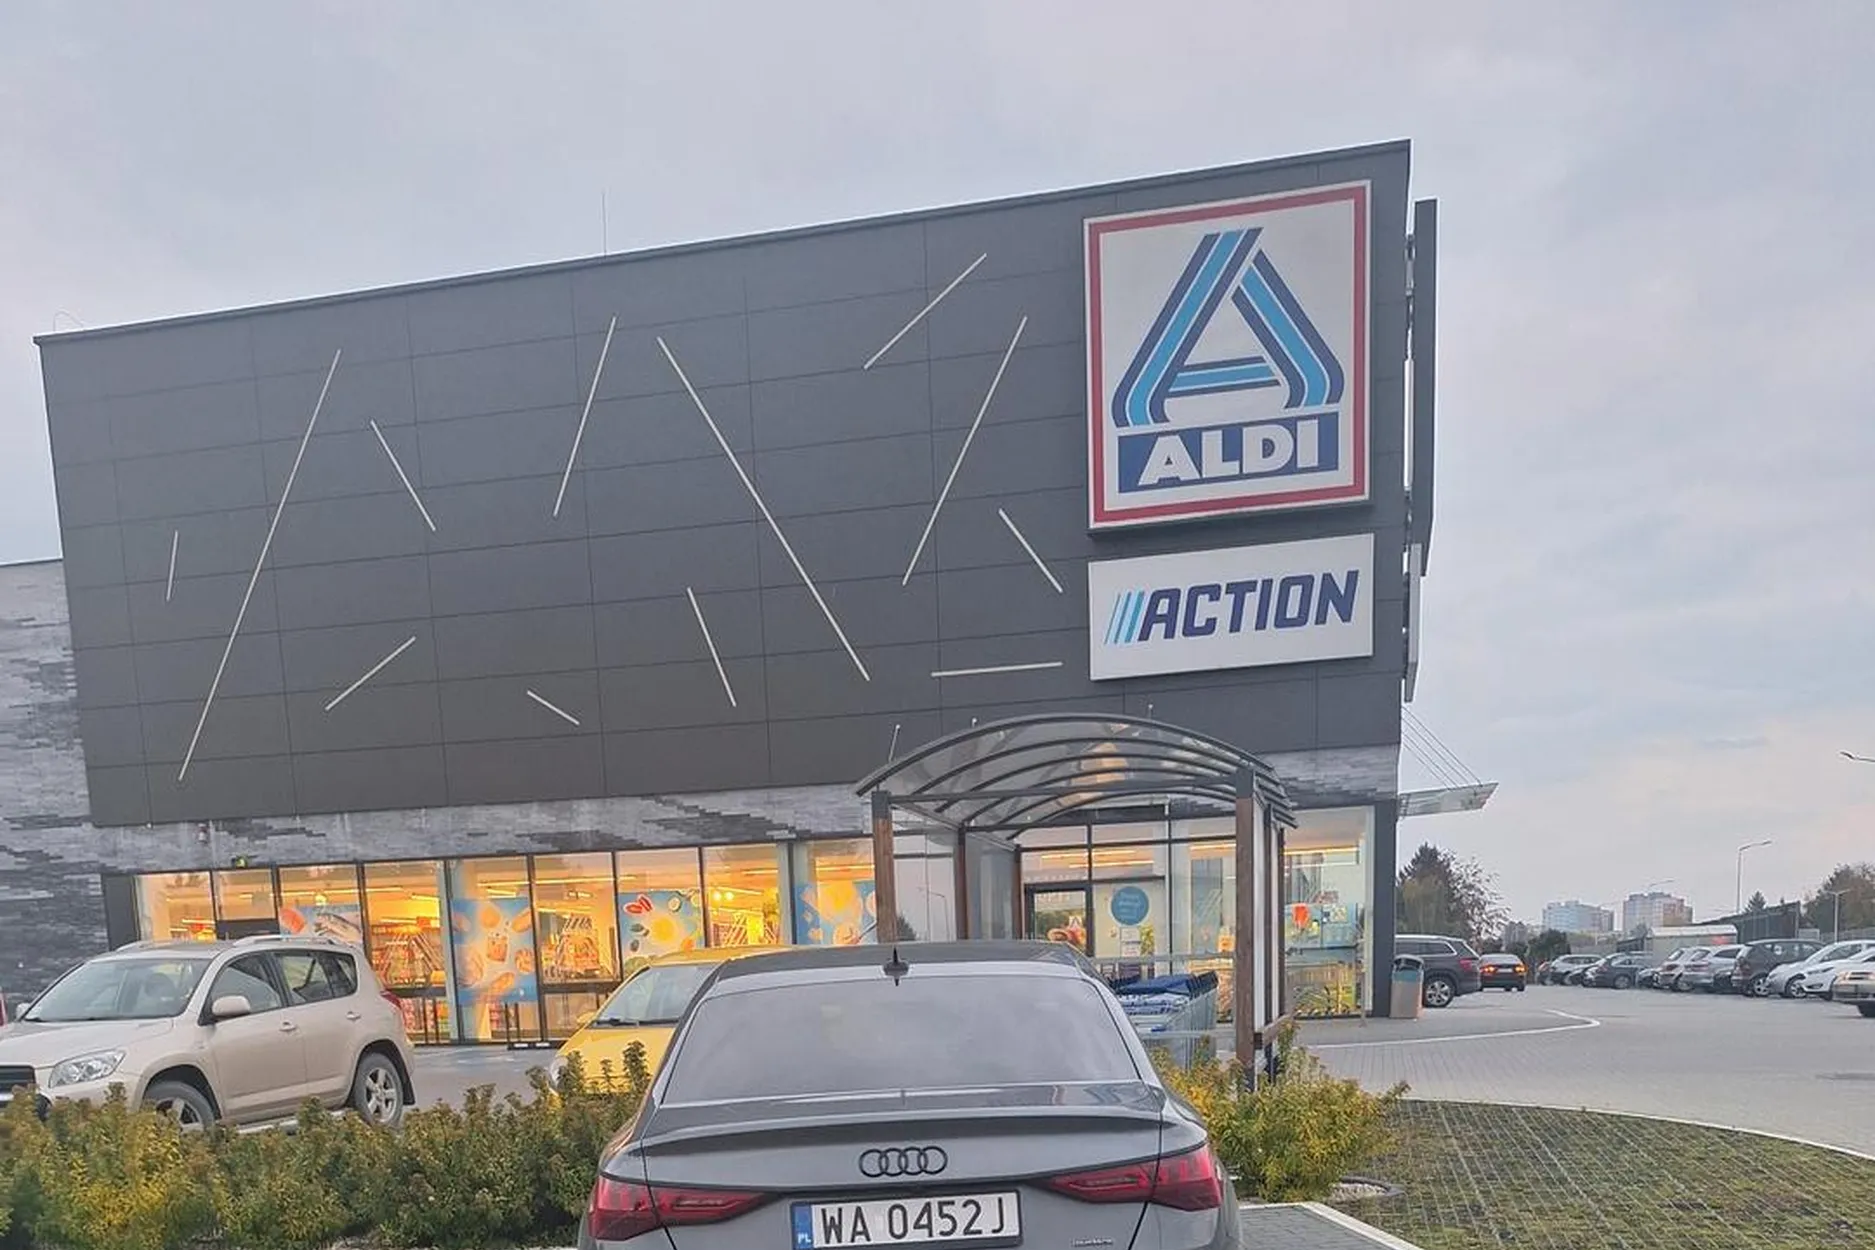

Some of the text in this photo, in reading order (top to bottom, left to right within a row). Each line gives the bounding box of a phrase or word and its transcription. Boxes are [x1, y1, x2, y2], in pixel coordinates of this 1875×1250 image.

[1138, 418, 1318, 486] ALDI
[1138, 570, 1360, 642] ACTION
[797, 1233, 812, 1244] PL
[820, 1196, 1005, 1245] WA 0452J
